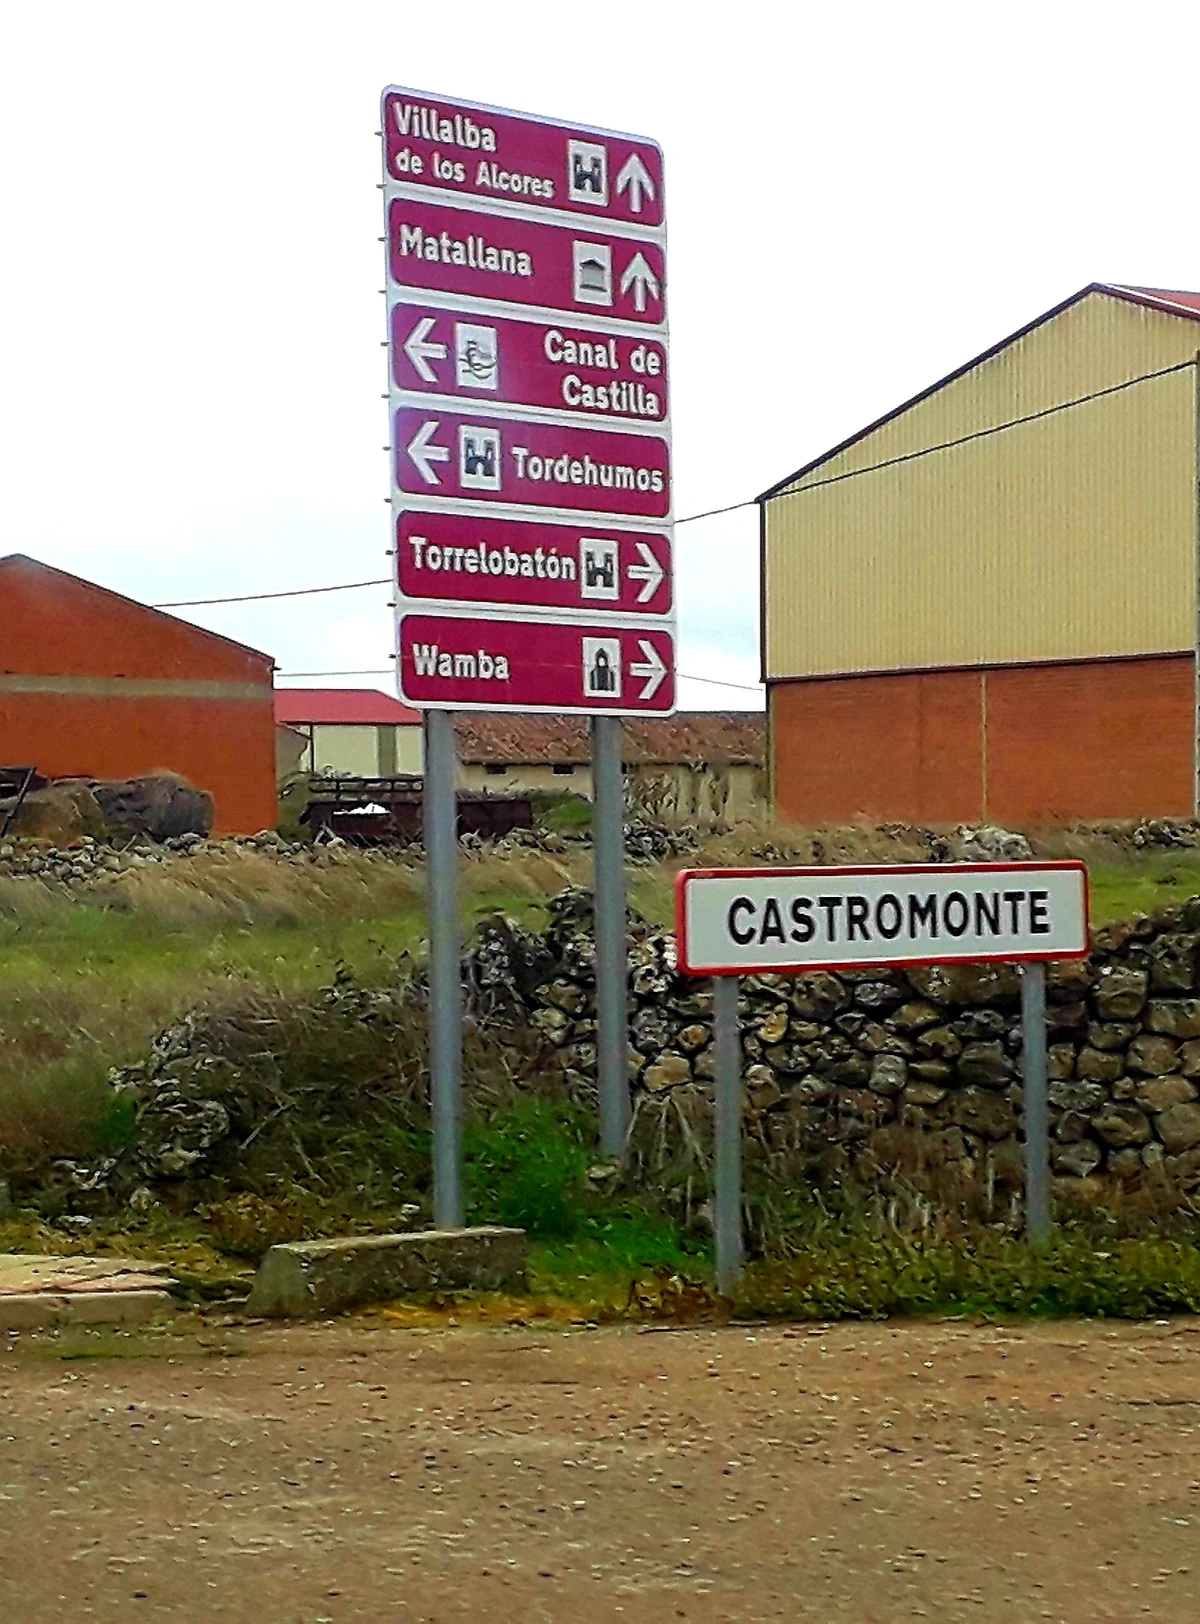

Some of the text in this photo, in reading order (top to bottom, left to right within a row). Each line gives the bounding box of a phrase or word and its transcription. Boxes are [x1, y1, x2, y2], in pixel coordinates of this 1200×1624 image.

[394, 101, 497, 153] Villalba
[395, 149, 555, 199] de los Alcores
[400, 224, 533, 277] Matallana
[544, 330, 661, 375] Canal de
[562, 374, 660, 416] Castilla
[512, 446, 665, 493] Tordehumos
[408, 536, 577, 581] Torrelobatón
[412, 644, 510, 680] Wamba
[728, 890, 1051, 946] CASTROMONTE
